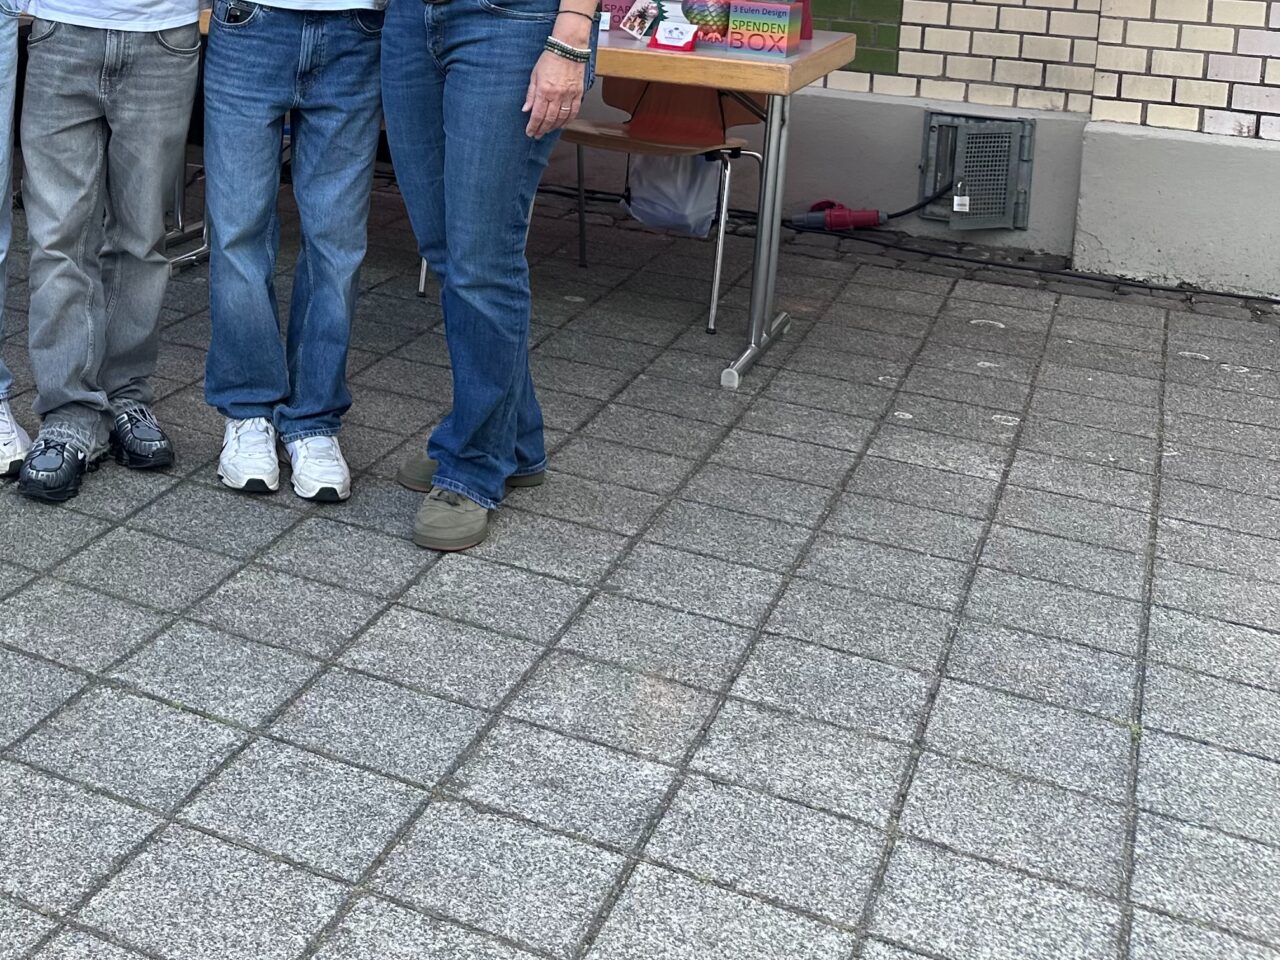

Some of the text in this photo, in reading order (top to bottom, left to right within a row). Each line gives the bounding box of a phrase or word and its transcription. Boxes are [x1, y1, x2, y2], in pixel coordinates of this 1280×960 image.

[732, 5, 787, 18] 3 Eulen Design
[731, 19, 786, 35] SPENDEN
[729, 31, 785, 54] BOX
